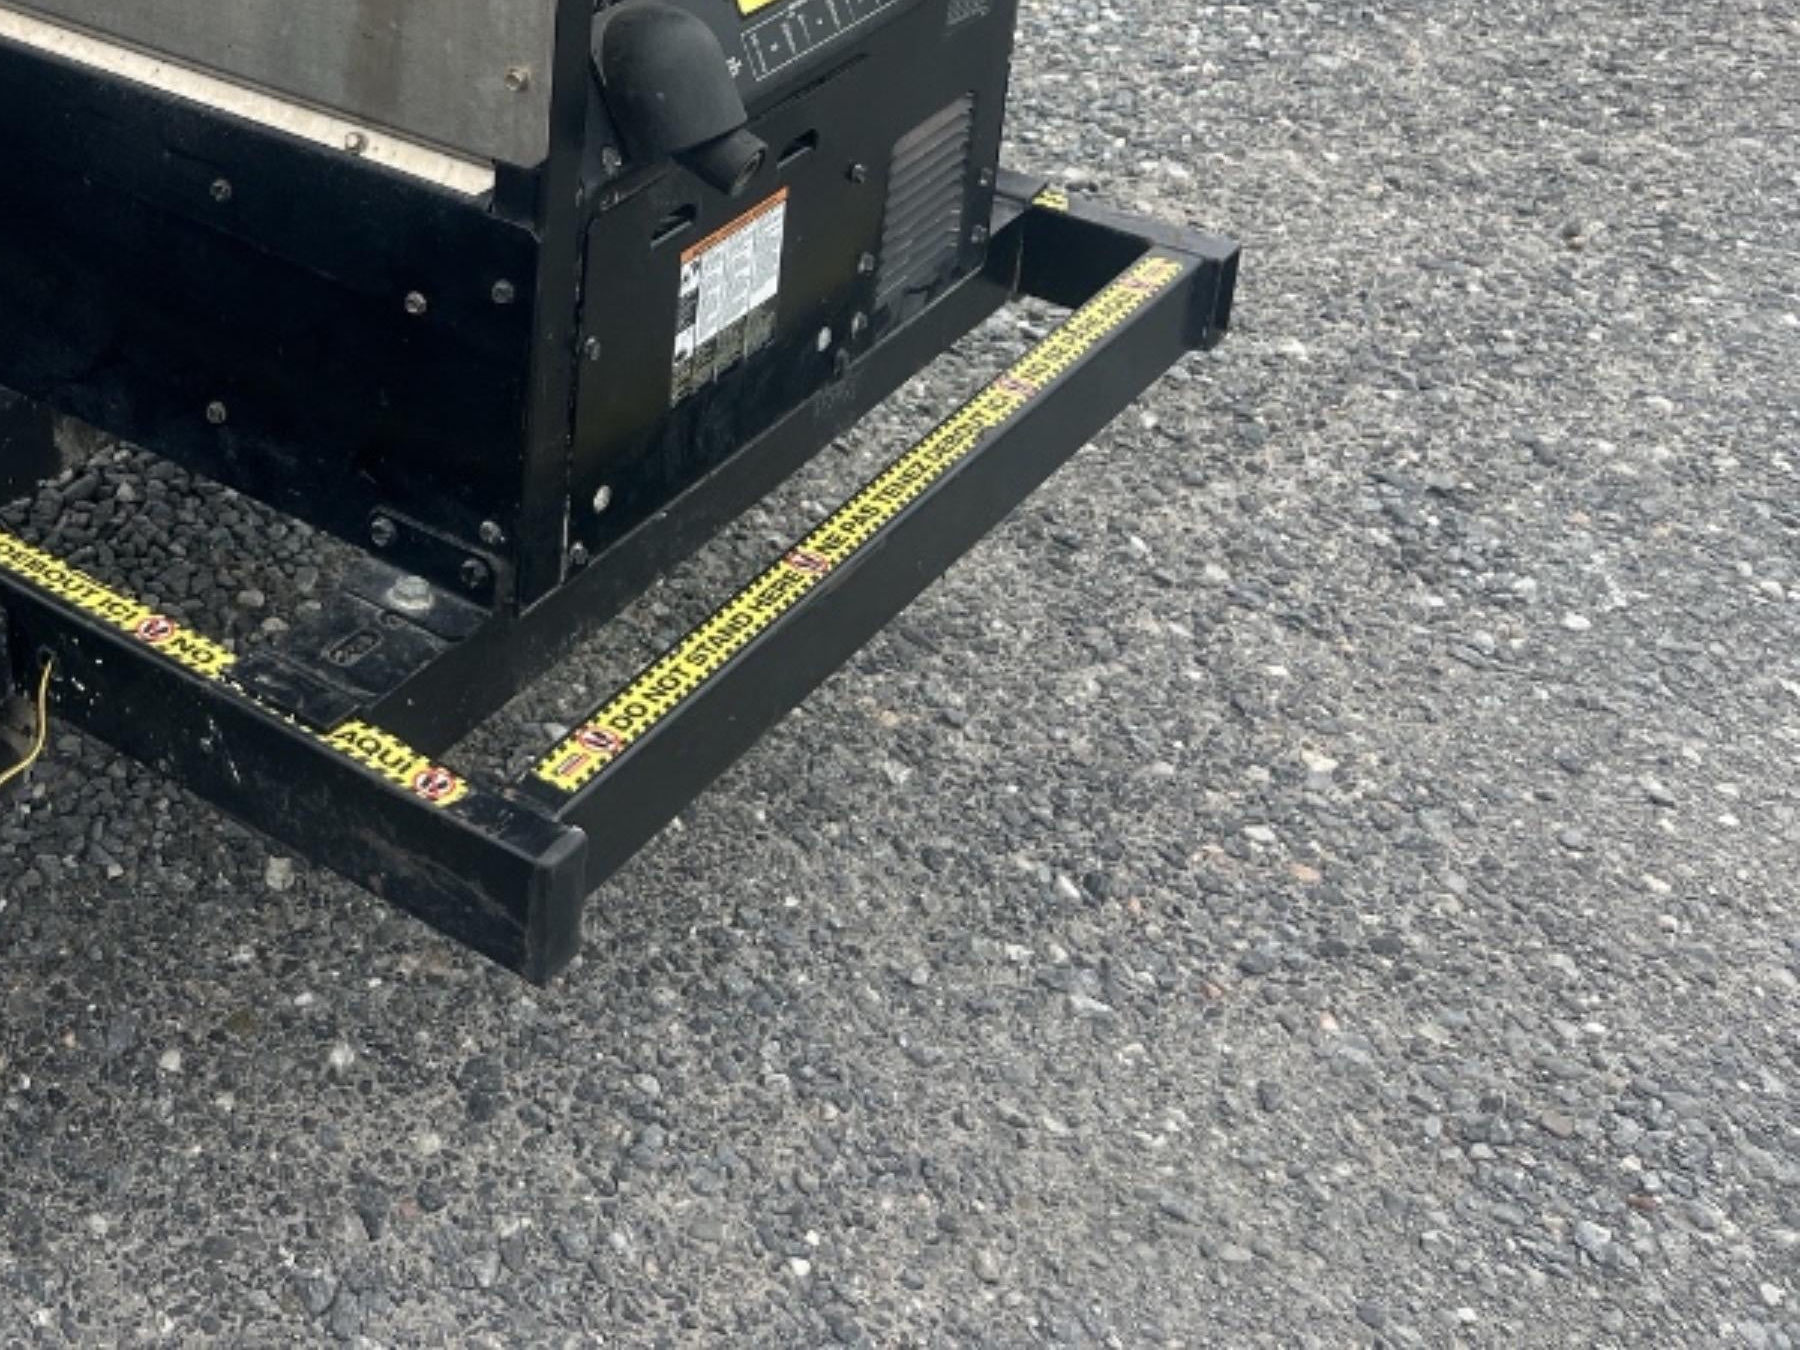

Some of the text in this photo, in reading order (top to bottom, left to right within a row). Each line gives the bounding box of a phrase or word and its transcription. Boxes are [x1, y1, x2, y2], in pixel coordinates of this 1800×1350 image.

[840, 503, 880, 534] PAS
[98, 595, 138, 622] ICI
[170, 635, 218, 665] NO
[609, 571, 802, 732] DO NOT STAND HERE
[333, 729, 412, 773] AQUI
